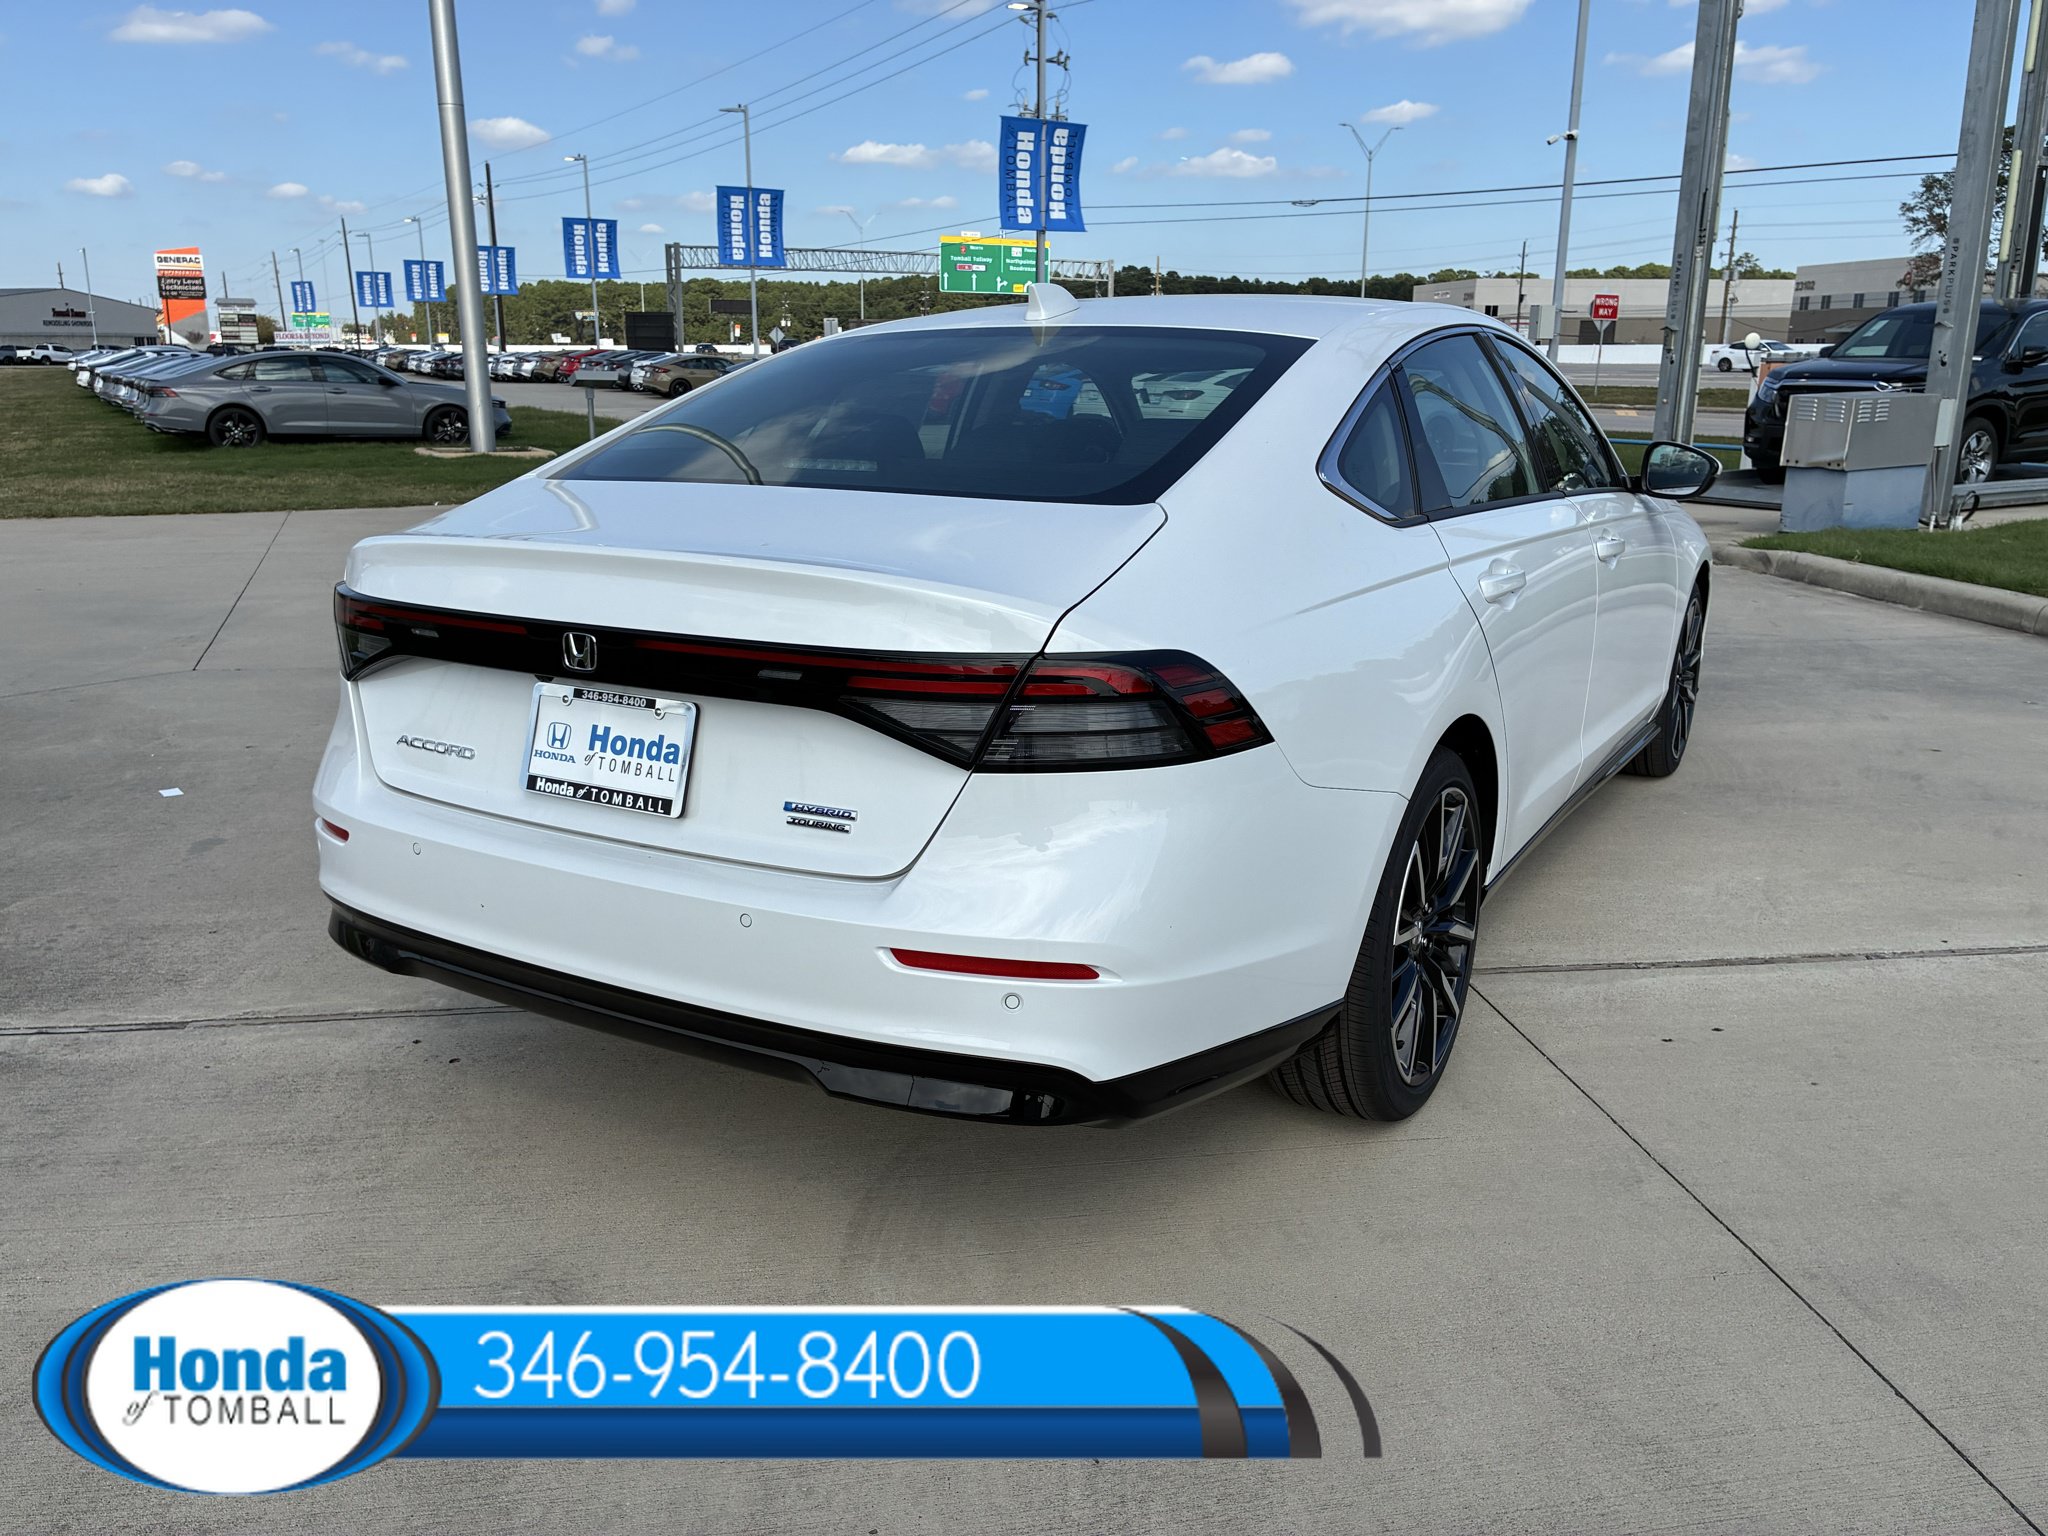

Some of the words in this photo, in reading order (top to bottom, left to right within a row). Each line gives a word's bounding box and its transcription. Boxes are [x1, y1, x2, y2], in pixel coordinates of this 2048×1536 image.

[1006, 145, 1017, 222] TOMBALL
[1016, 131, 1035, 224] Honda
[1049, 128, 1069, 220] Honda
[1065, 131, 1078, 206] TOMBALL
[730, 195, 746, 260] Honda
[757, 193, 772, 257] Honda
[573, 224, 587, 275] Honda
[595, 222, 609, 273] Honda
[377, 273, 387, 304] Honda
[411, 264, 422, 300] Honda
[428, 263, 439, 298] Honda
[478, 250, 490, 292] Honda
[497, 249, 509, 291] Honda
[363, 275, 373, 305] Honda
[1596, 297, 1618, 306] WRONG
[1598, 308, 1613, 316] WAY
[396, 734, 476, 760] ACCORD
[533, 748, 576, 764] HONDA
[588, 723, 681, 765] Honda
[584, 751, 599, 766] of
[598, 755, 676, 783] TOMBALL
[535, 776, 574, 797] Honda
[576, 785, 590, 798] of
[590, 788, 665, 814] TOMBALL
[793, 804, 853, 819] HYBRID
[789, 817, 847, 832] TOURING
